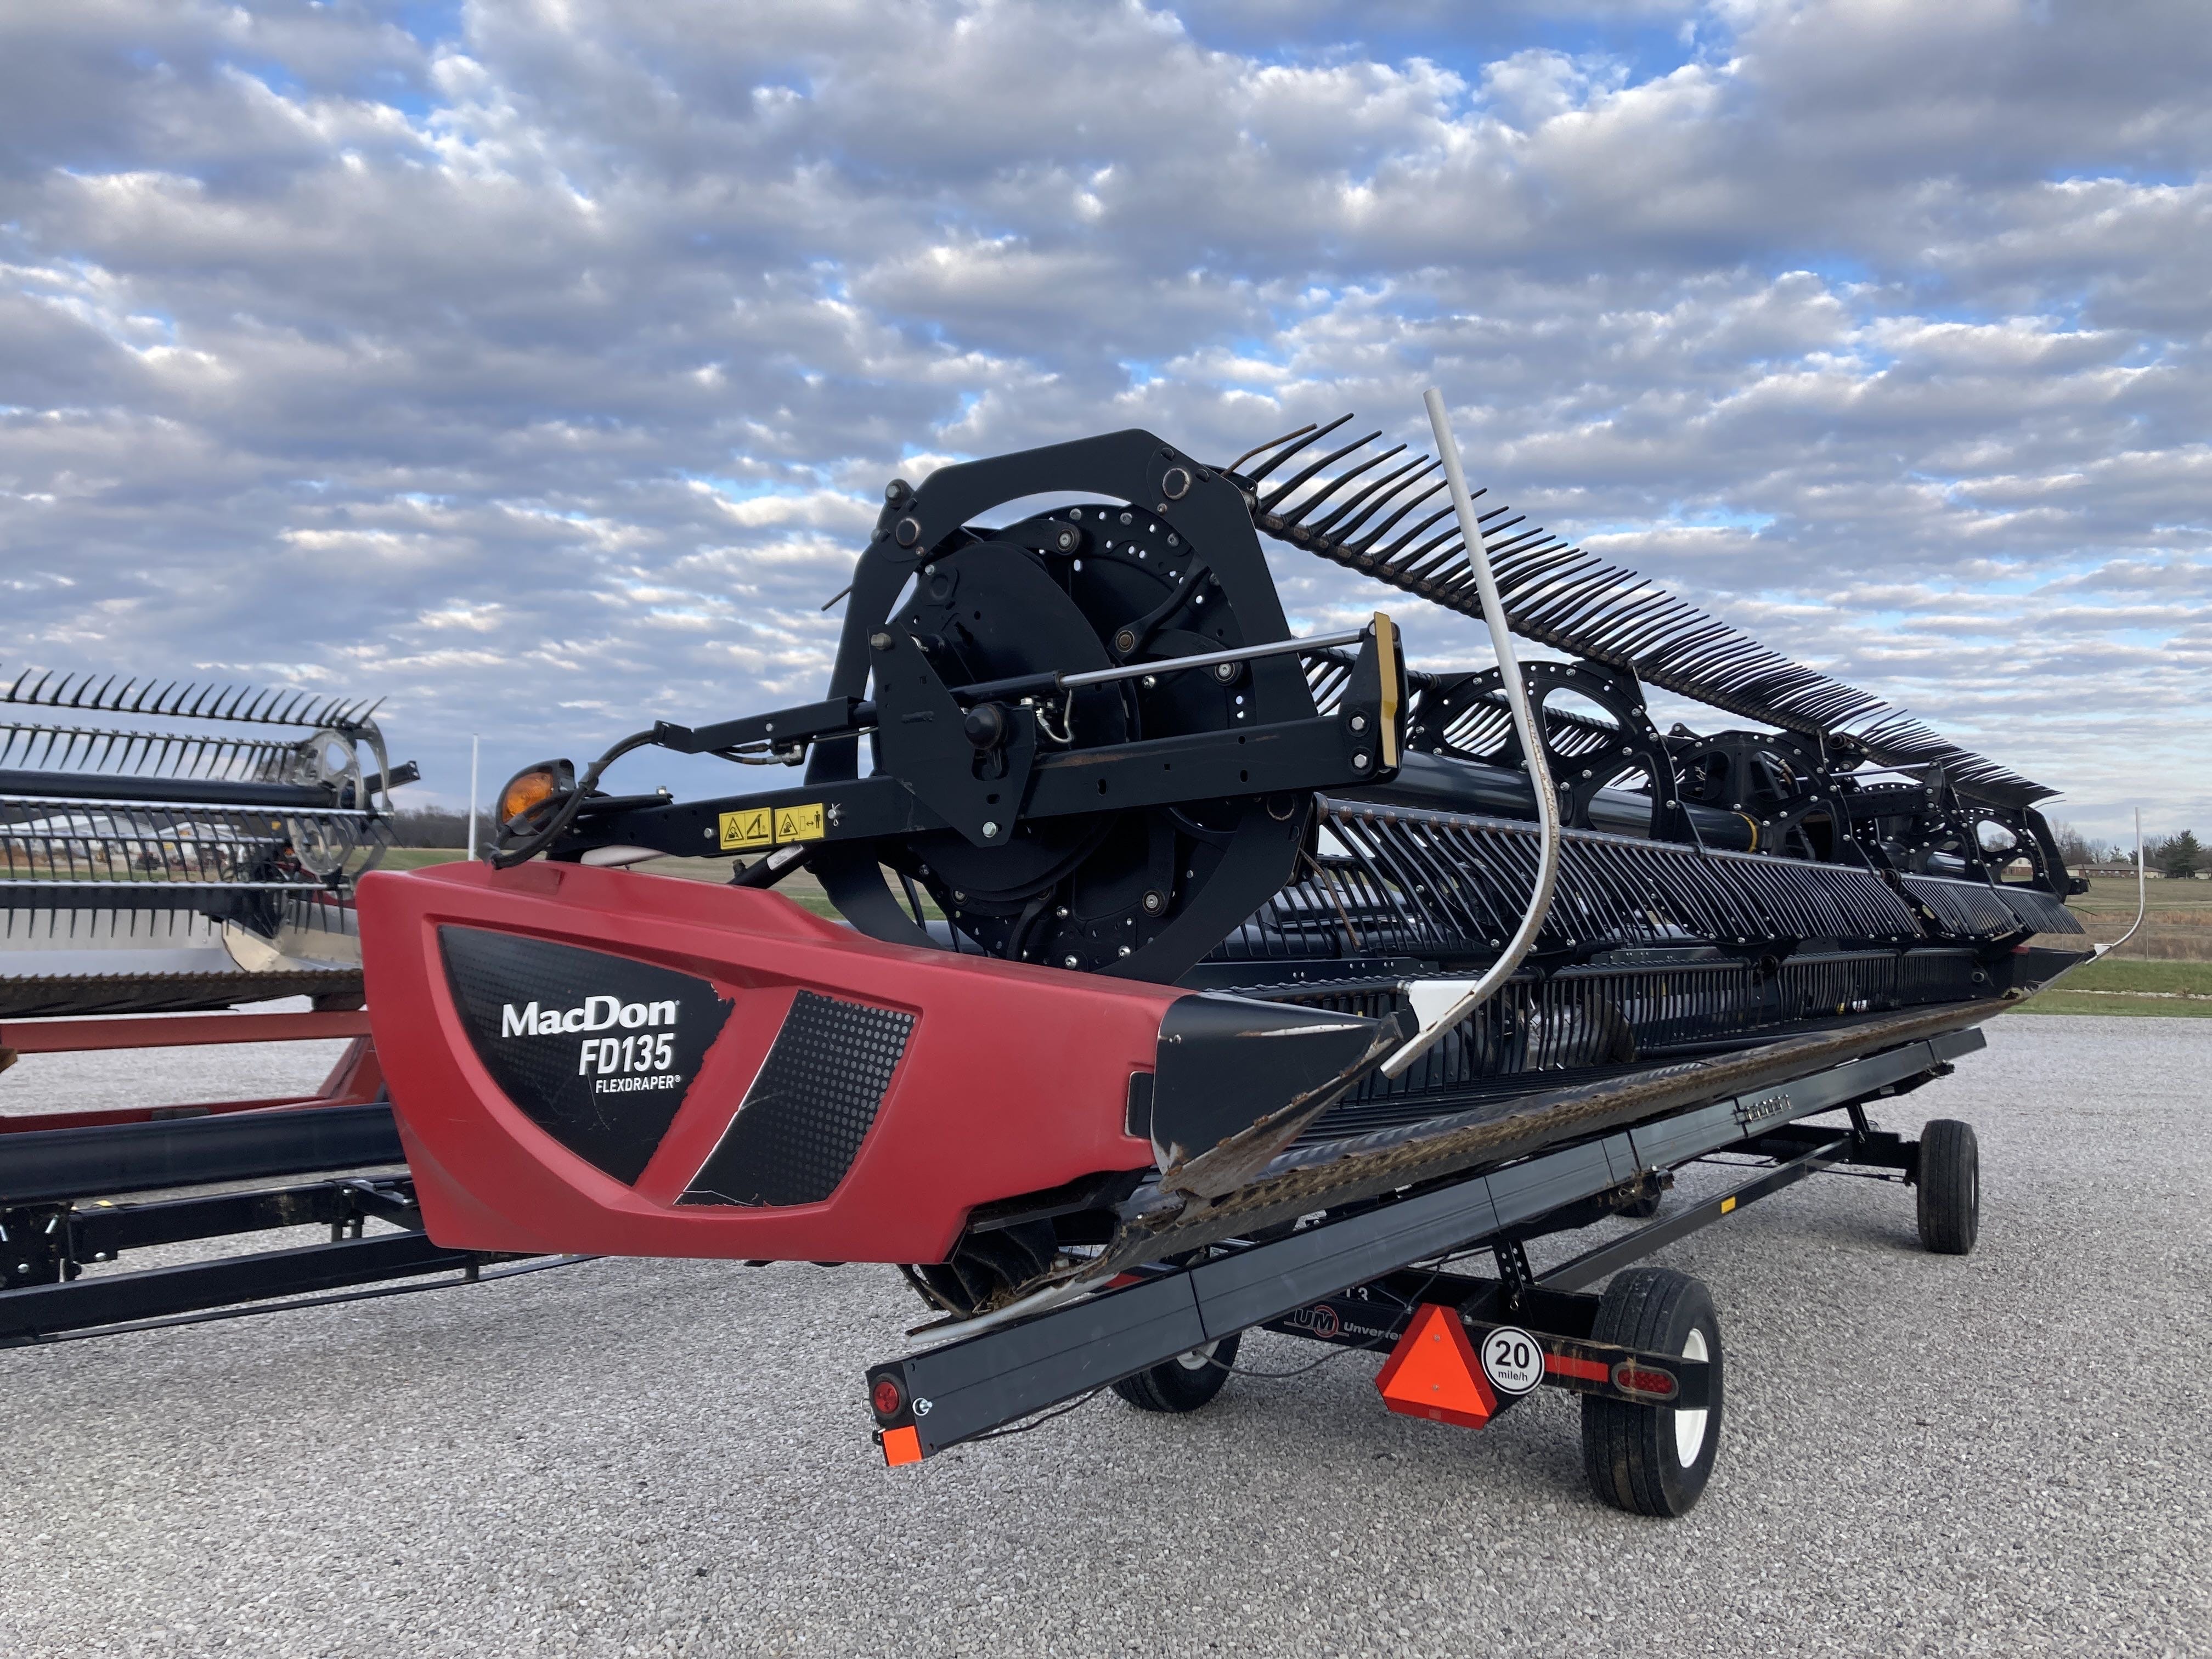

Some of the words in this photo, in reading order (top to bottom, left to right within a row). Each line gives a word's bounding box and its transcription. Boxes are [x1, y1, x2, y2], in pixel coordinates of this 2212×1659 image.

[501, 995, 676, 1037] MacDon
[579, 1032, 675, 1076] FD135
[1495, 1340, 1530, 1369] 20
[1498, 1370, 1528, 1382] mile/h
